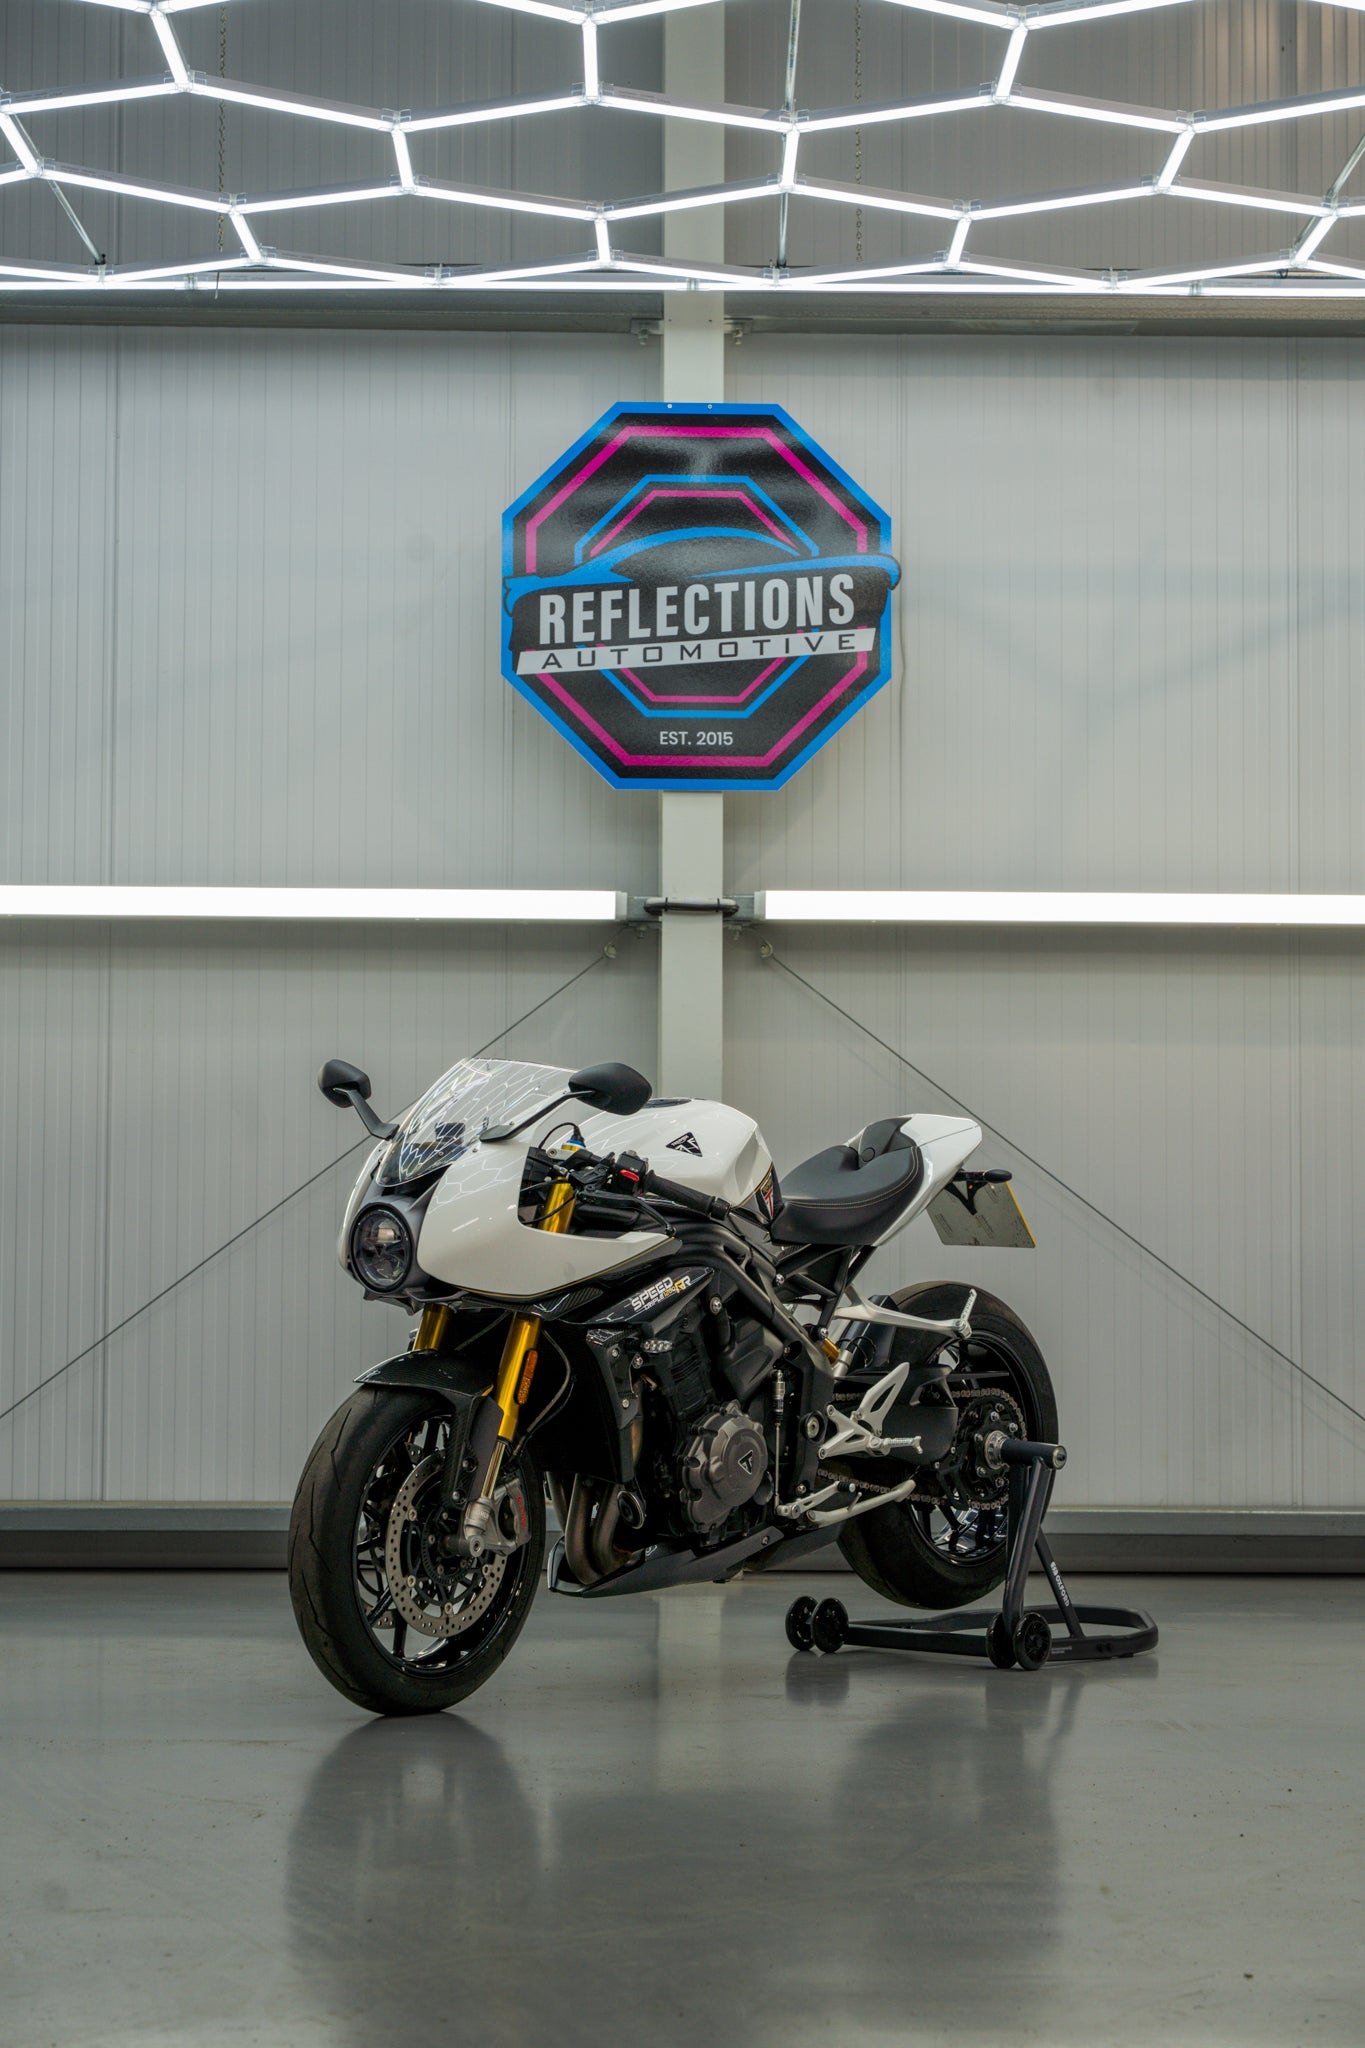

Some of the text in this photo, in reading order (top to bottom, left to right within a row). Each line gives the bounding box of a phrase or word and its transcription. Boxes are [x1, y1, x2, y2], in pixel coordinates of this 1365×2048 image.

[539, 573, 855, 645] REFLECTIONS
[541, 633, 856, 670] AUTOMOTIVE
[659, 730, 734, 746] EST. 2015
[631, 1276, 674, 1312] SPEED
[674, 1275, 692, 1294] RR
[1055, 1574, 1070, 1607] OXFORD
